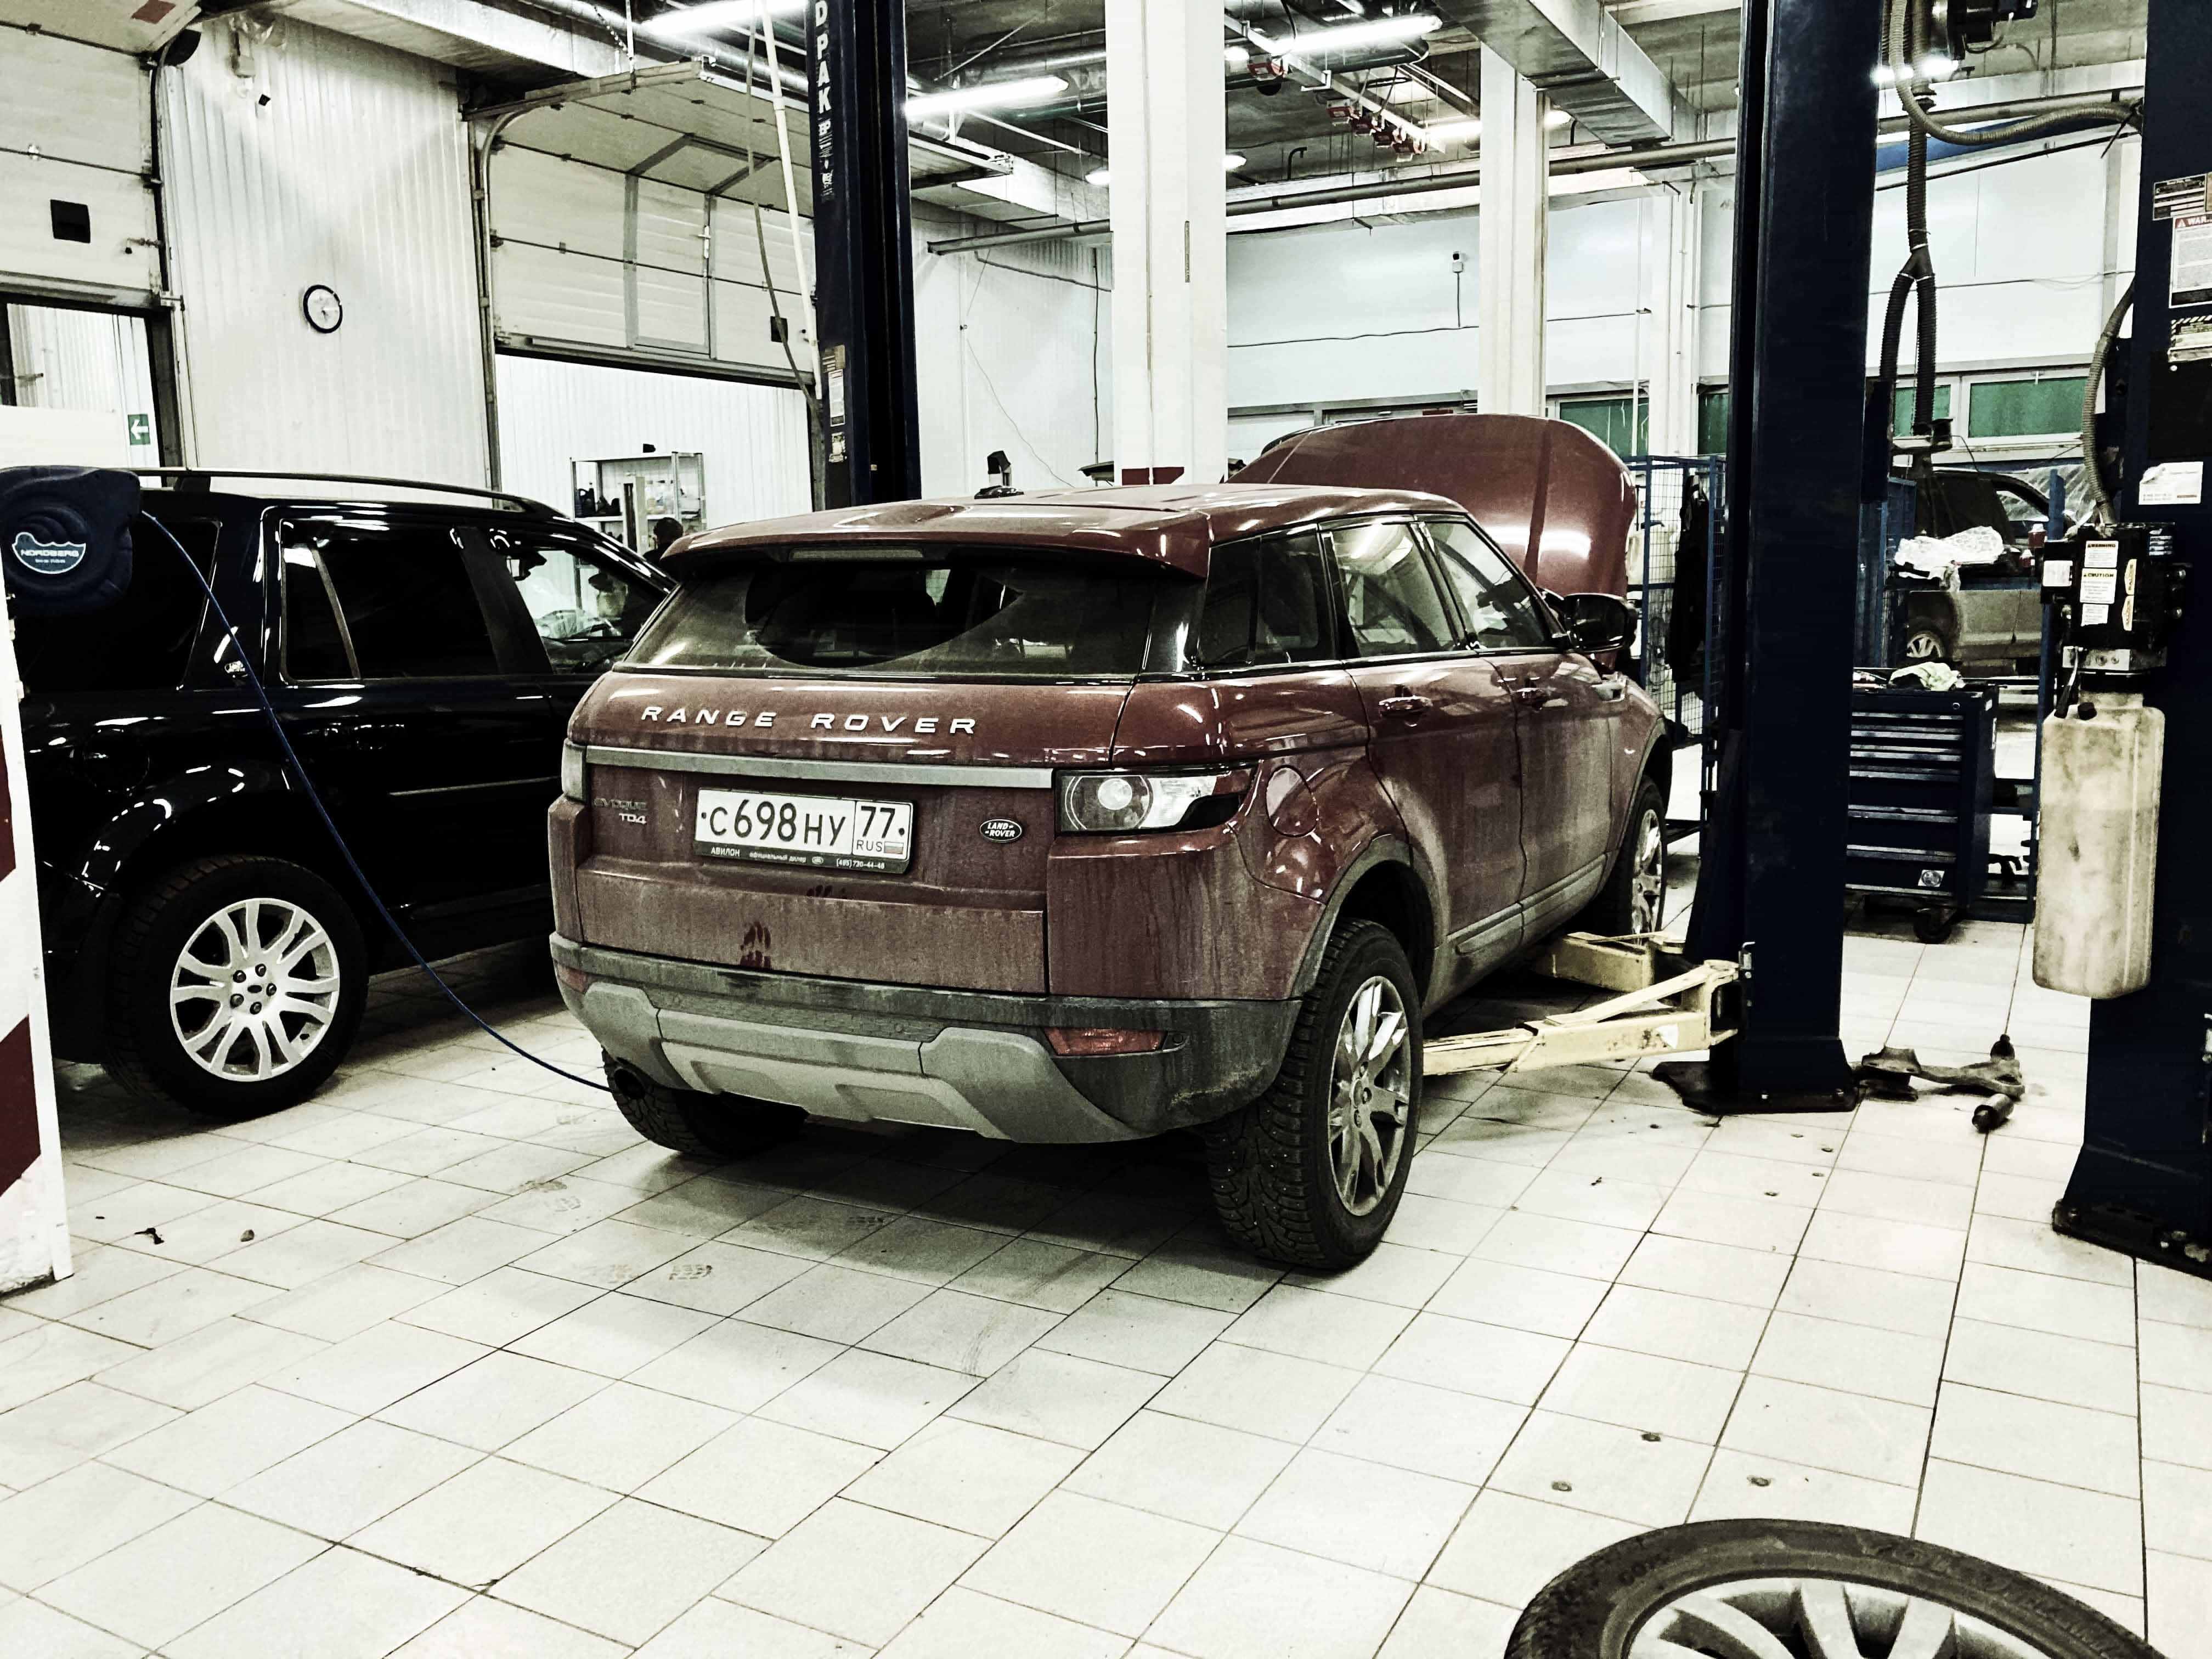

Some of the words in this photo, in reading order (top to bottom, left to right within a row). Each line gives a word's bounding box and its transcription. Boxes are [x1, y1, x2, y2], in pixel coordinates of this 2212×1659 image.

[641, 706, 777, 727] RANGE
[810, 713, 976, 735] ROVER
[618, 813, 647, 825] TD4
[988, 822, 1009, 830] LAND
[989, 829, 1016, 837] ROVER
[856, 840, 883, 852] RUS
[710, 847, 740, 857] АВИЛОН
